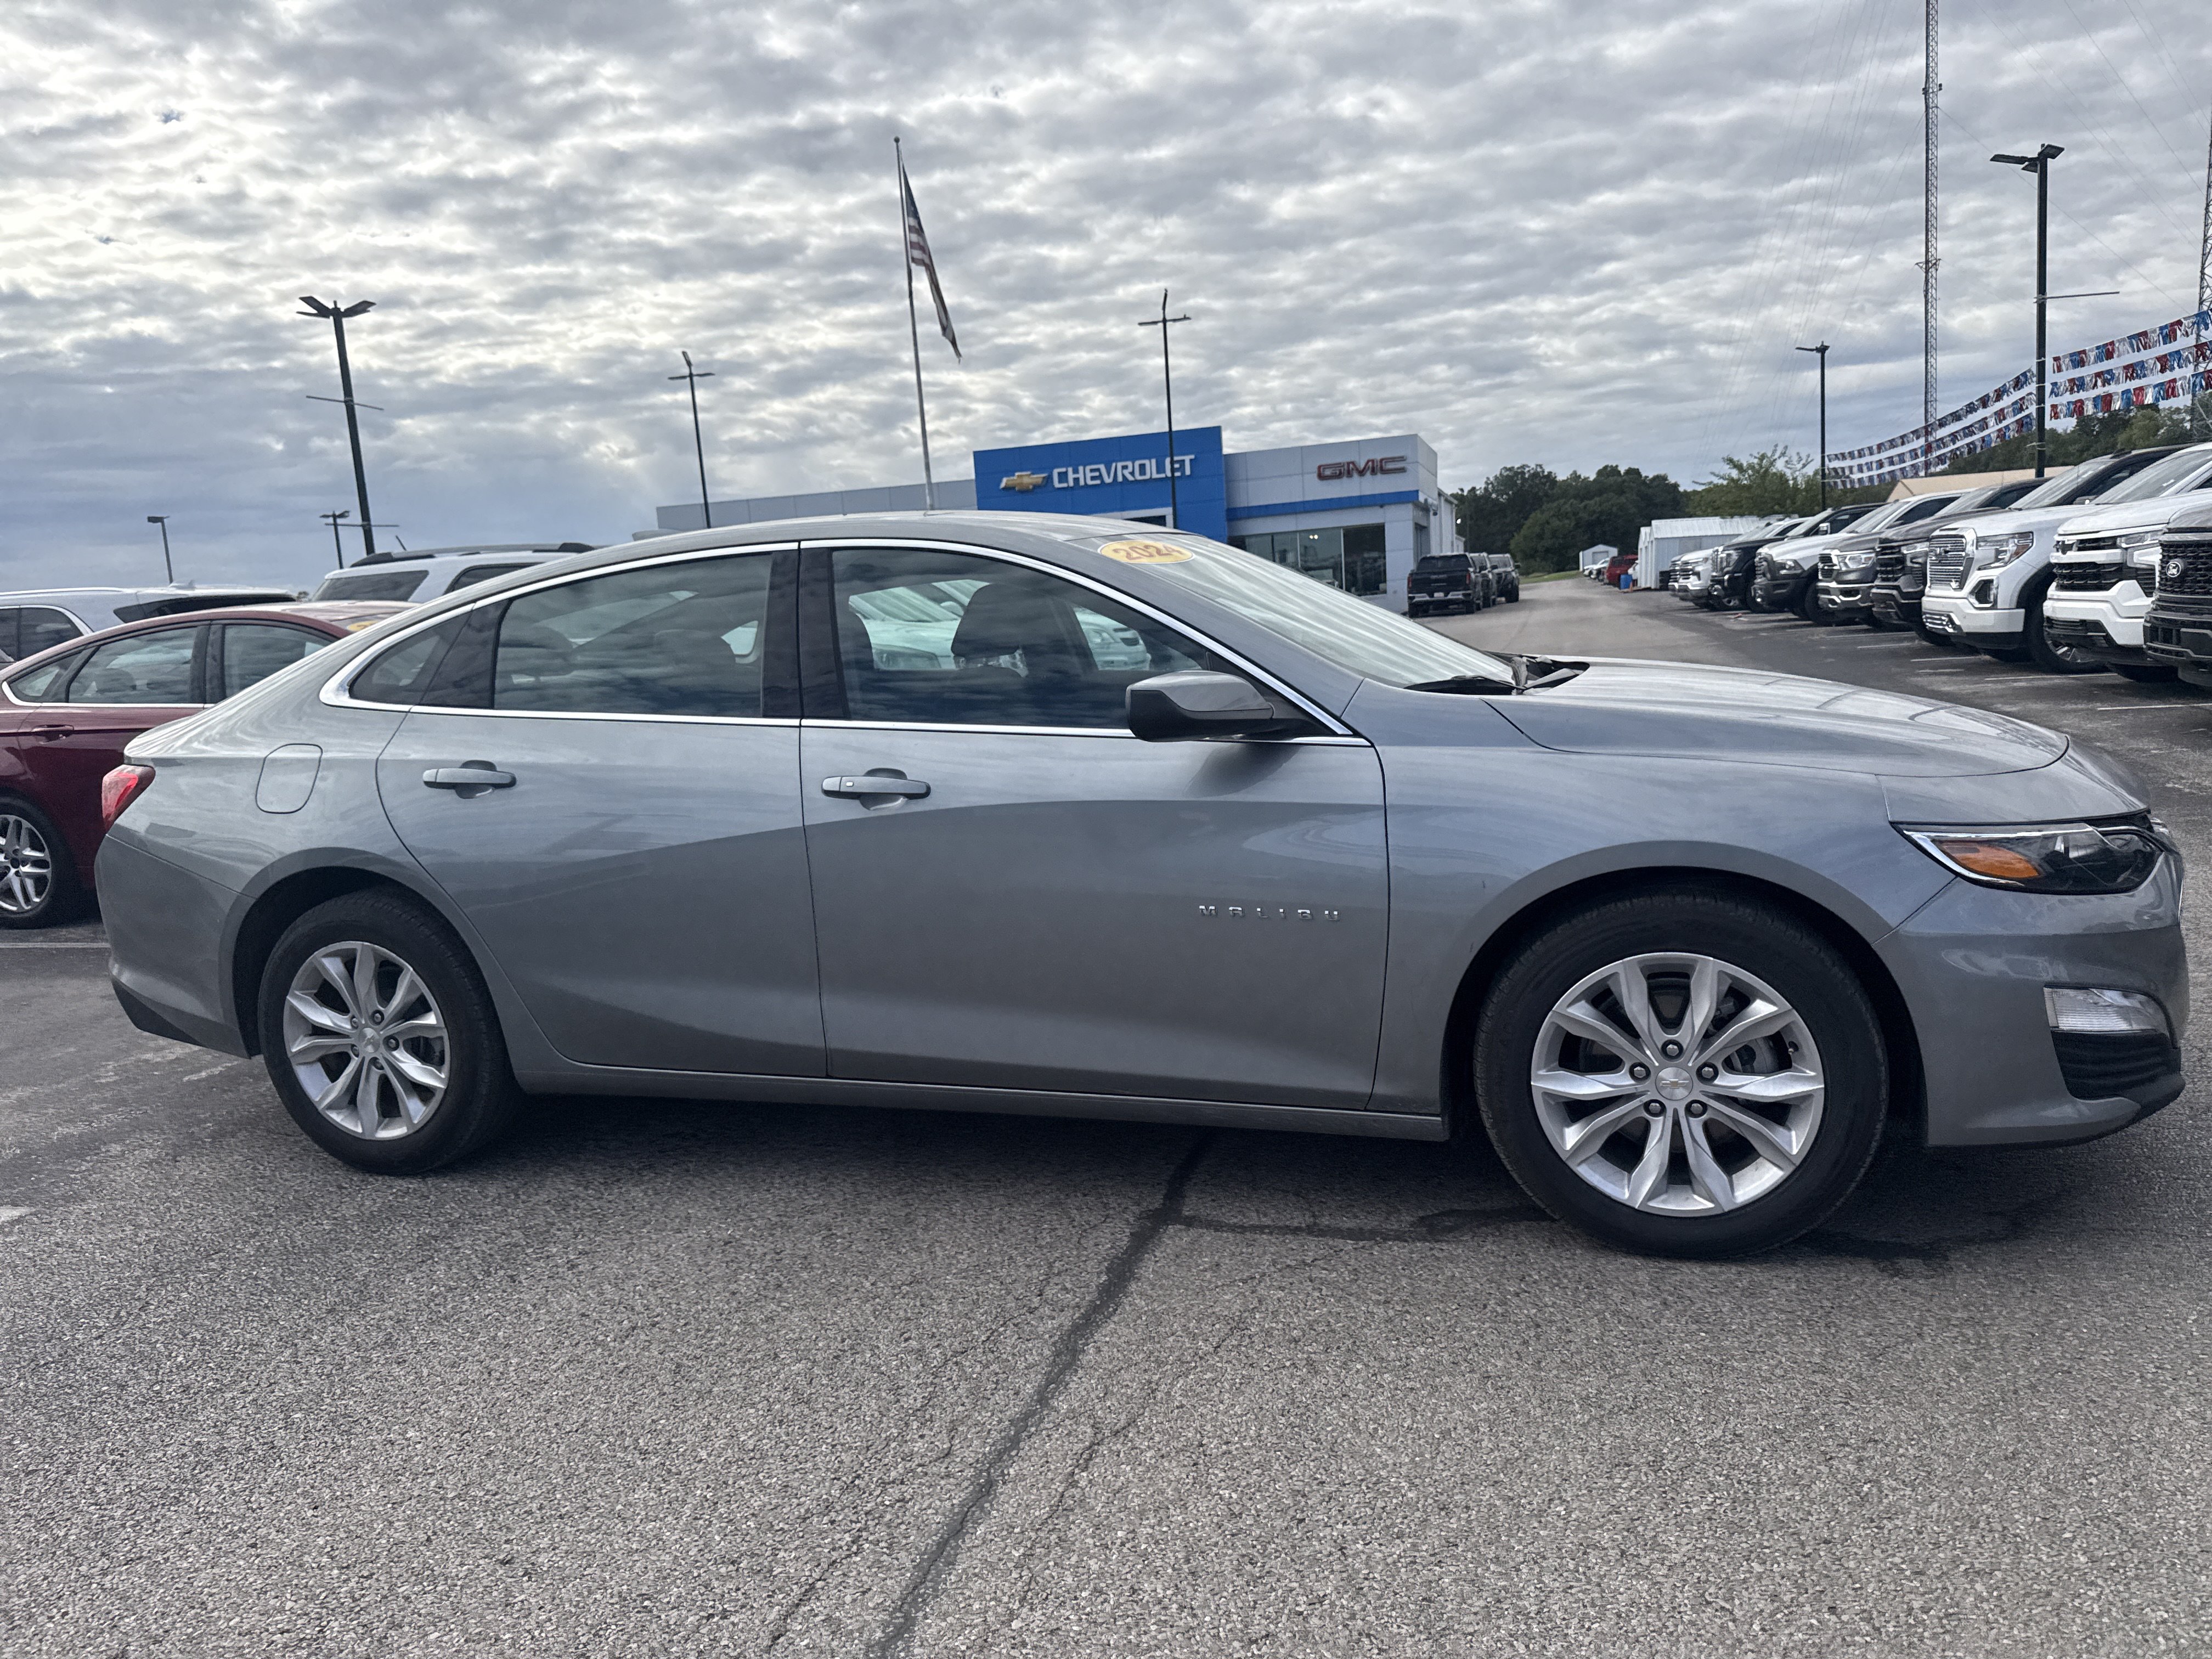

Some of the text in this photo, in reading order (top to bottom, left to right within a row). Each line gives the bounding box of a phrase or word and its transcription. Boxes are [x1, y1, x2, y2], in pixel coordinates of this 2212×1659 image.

[1053, 454, 1195, 488] CHEVROLET
[1317, 455, 1407, 481] GMC
[1112, 544, 1184, 561] 2024
[1199, 905, 1340, 921] MALIBU
